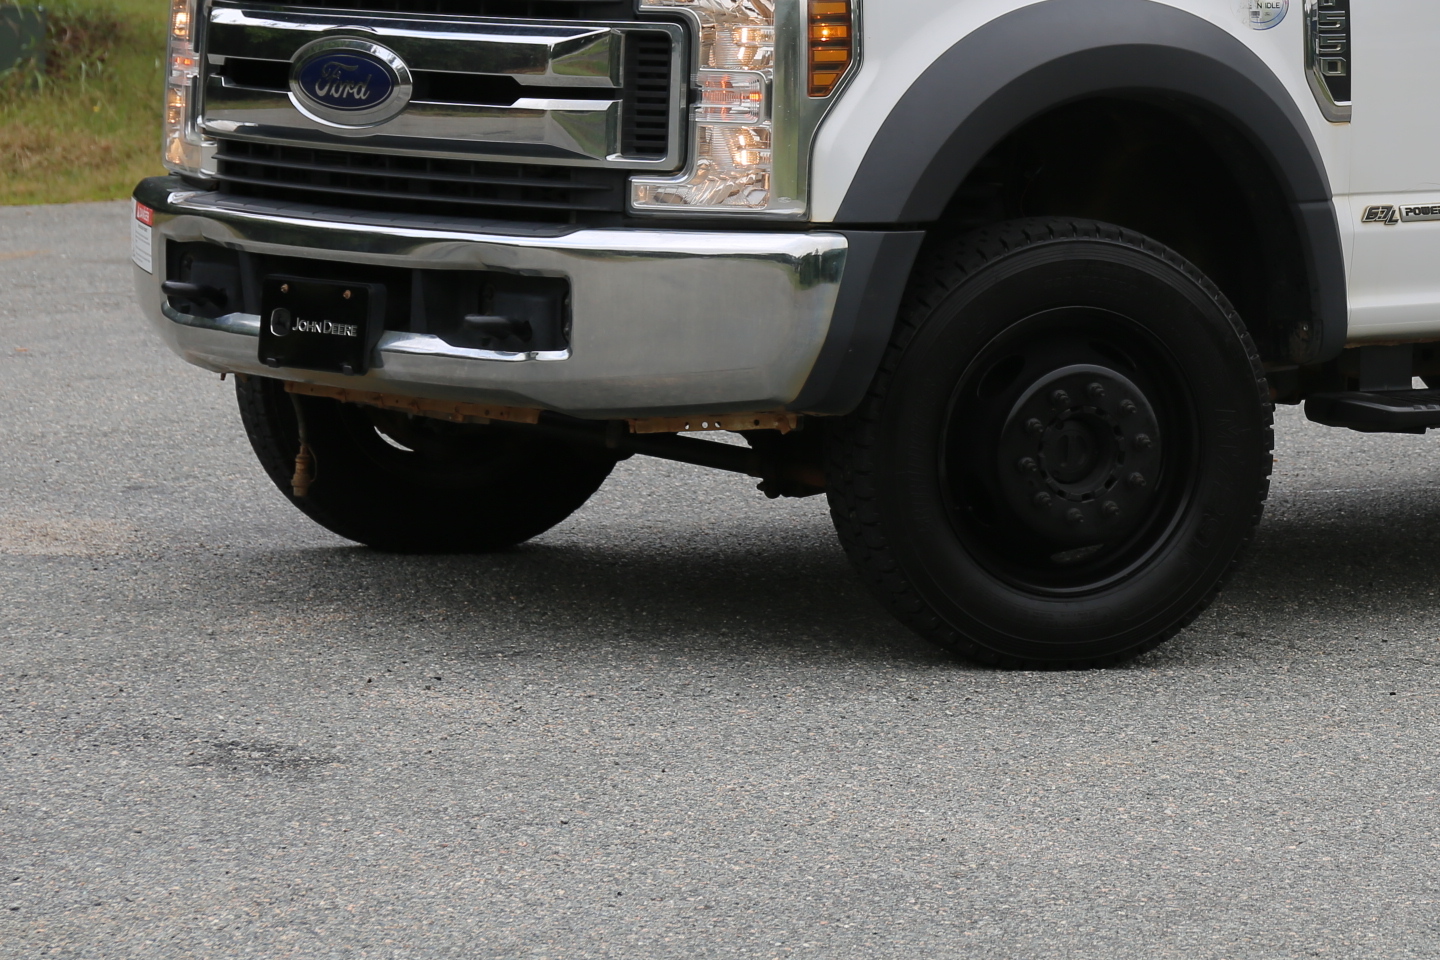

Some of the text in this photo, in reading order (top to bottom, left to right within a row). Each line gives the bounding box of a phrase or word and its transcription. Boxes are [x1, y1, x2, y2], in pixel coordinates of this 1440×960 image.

[315, 61, 372, 100] Ford
[292, 317, 358, 337] JOHN DEERE
